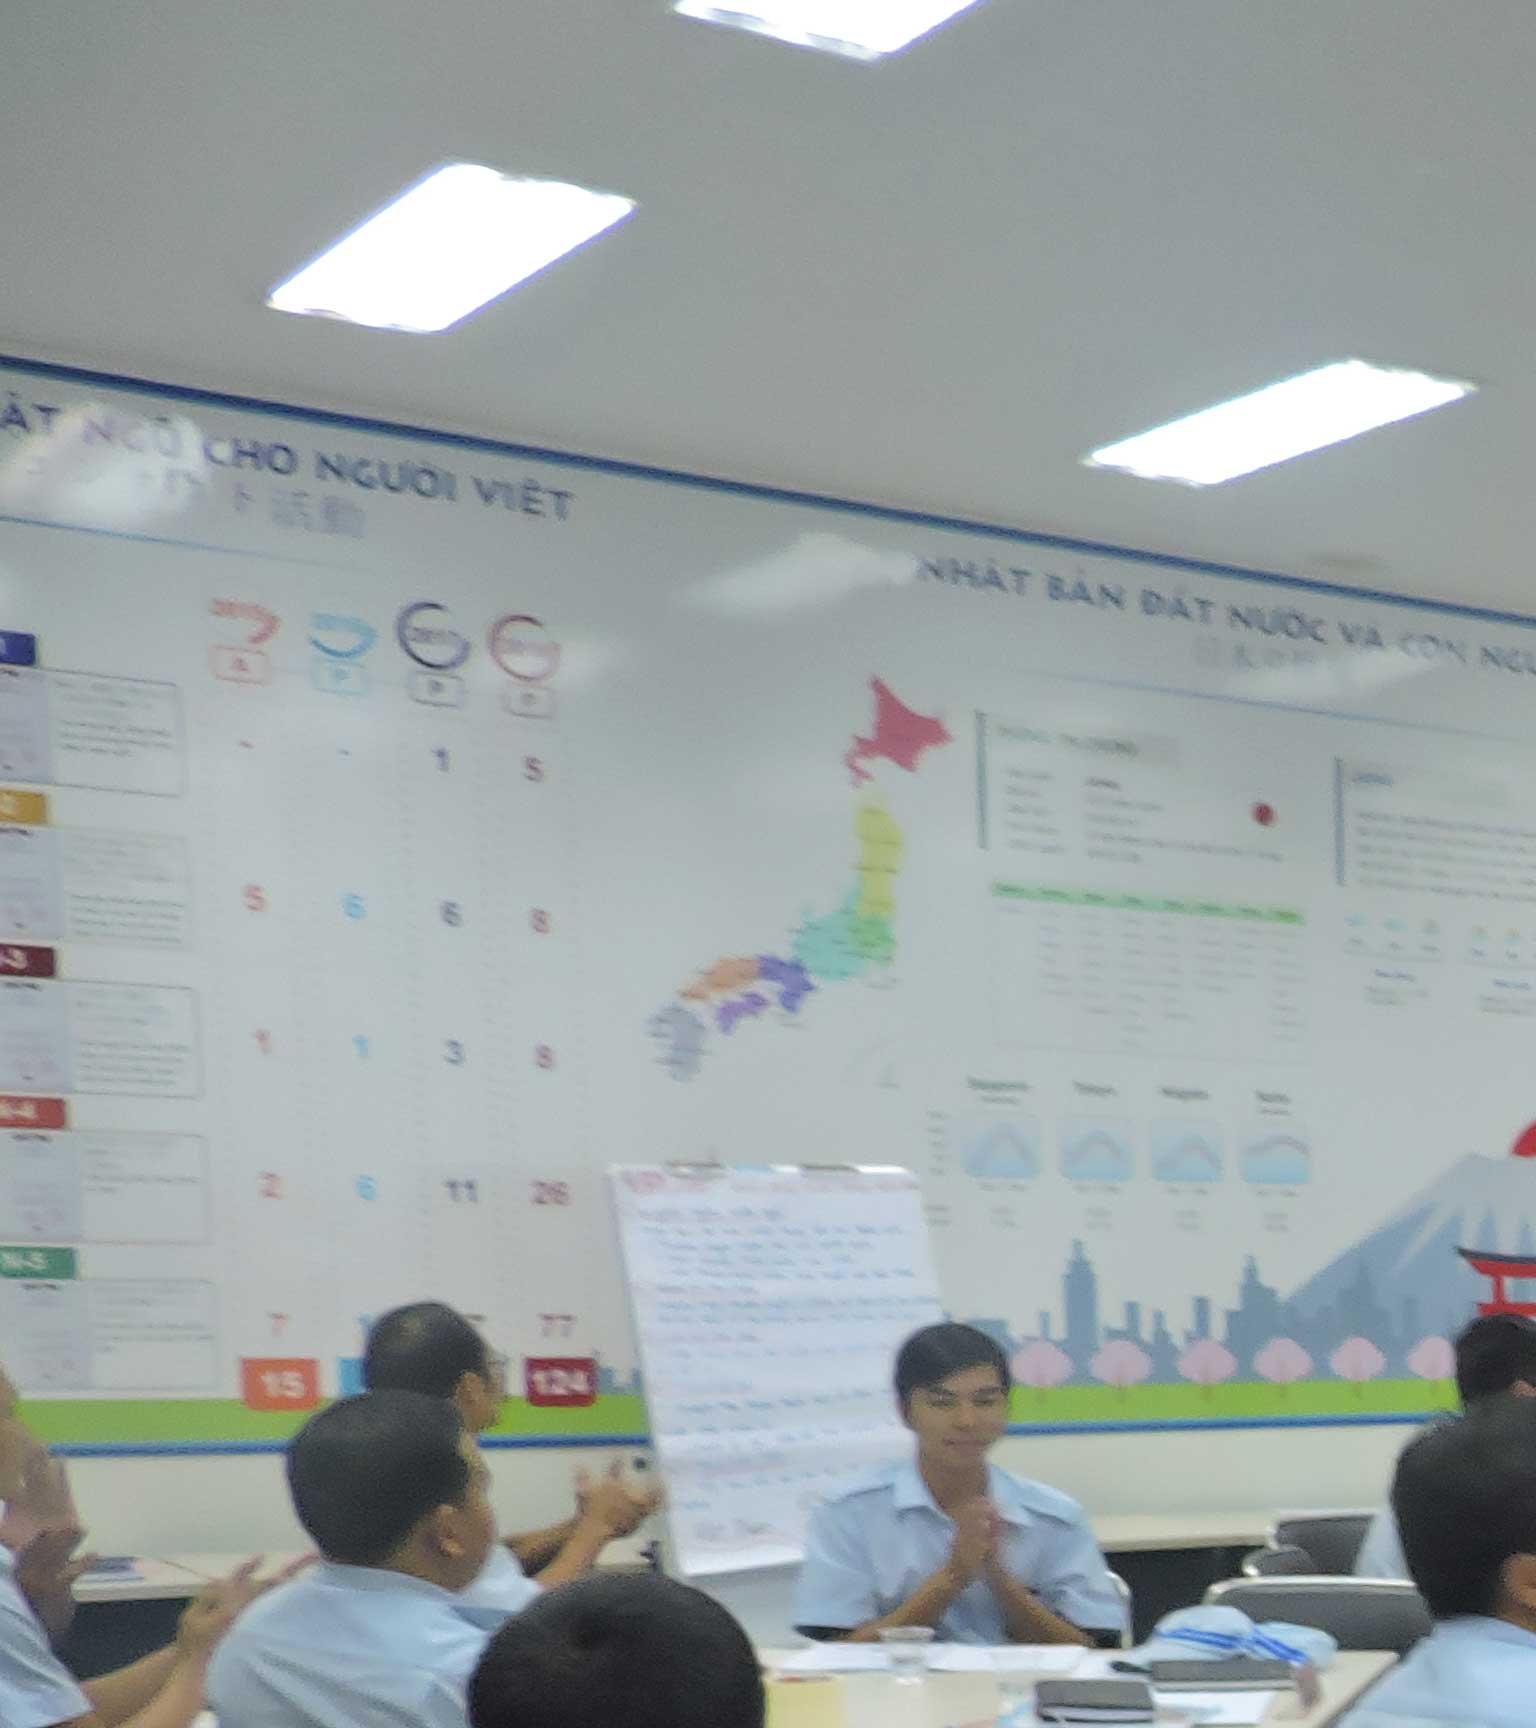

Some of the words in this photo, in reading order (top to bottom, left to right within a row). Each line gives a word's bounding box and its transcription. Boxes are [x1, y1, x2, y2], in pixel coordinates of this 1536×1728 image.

[204, 437, 298, 475] CHO
[522, 754, 546, 784] 5
[243, 883, 268, 913] 5
[442, 1037, 466, 1067] 3
[257, 1170, 284, 1201] 2
[442, 1175, 480, 1204] 11
[537, 1312, 577, 1339] 77
[260, 1369, 306, 1398] 15
[530, 1367, 593, 1396] 124
